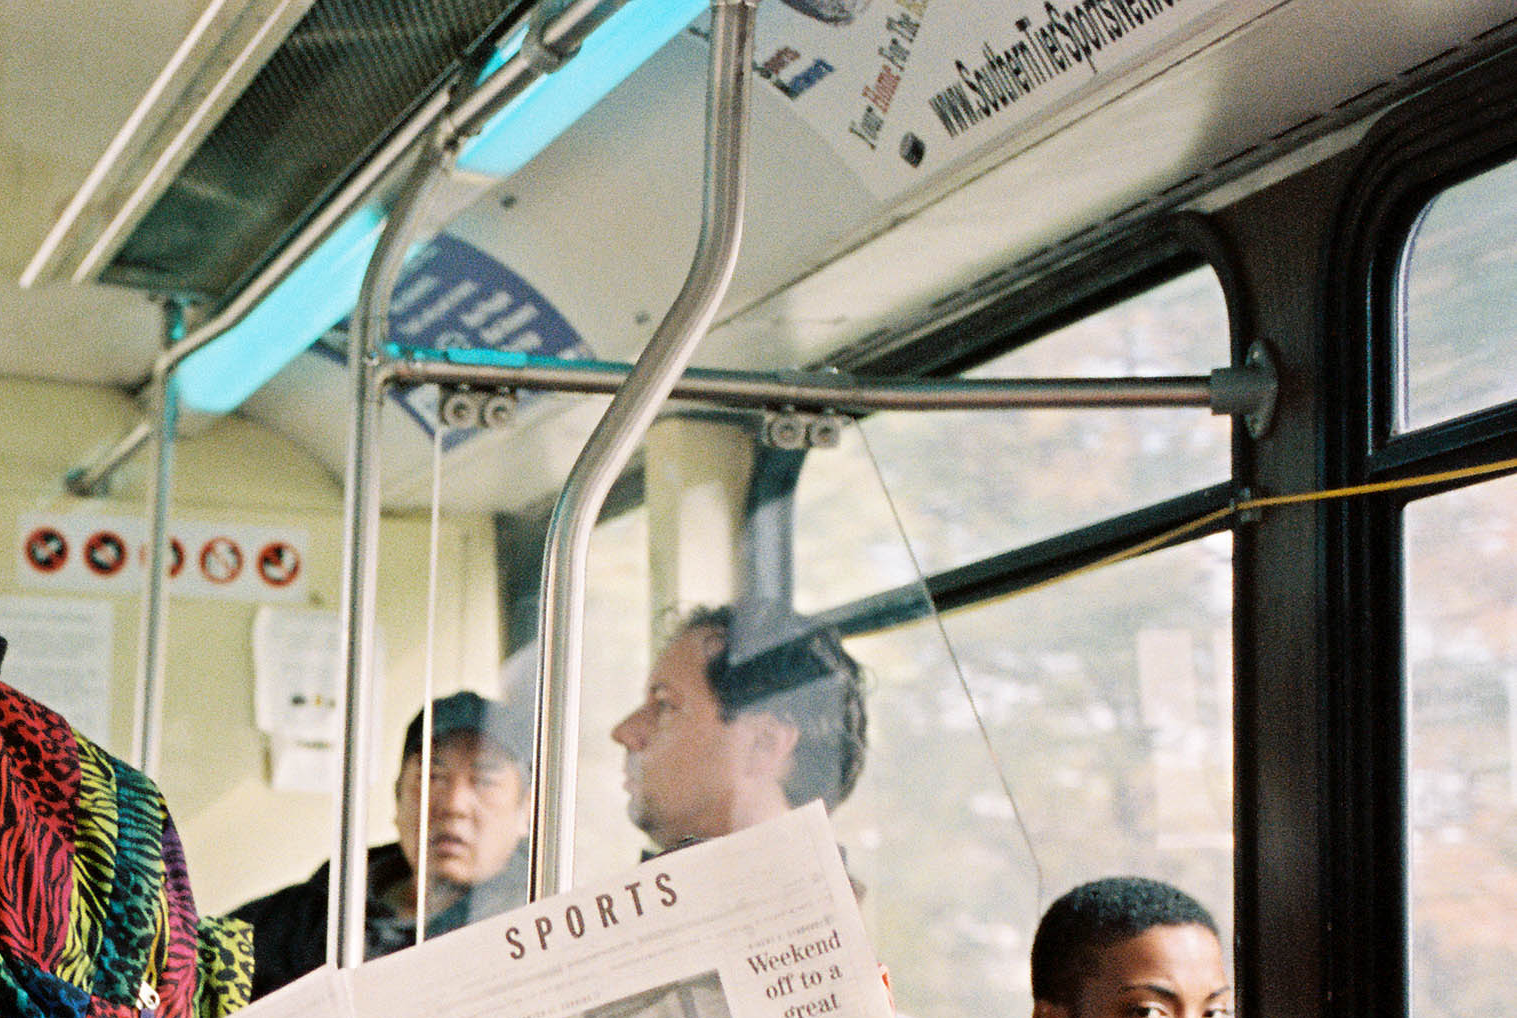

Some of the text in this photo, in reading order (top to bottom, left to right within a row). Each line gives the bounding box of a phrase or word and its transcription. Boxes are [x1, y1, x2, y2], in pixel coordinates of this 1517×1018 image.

[886, 13, 920, 43] The
[878, 38, 910, 71] For
[862, 64, 901, 113] Home
[849, 106, 885, 149] Your
[505, 872, 677, 959] SPORTS
[747, 929, 841, 975] Weekend
[766, 964, 843, 1000] off to a
